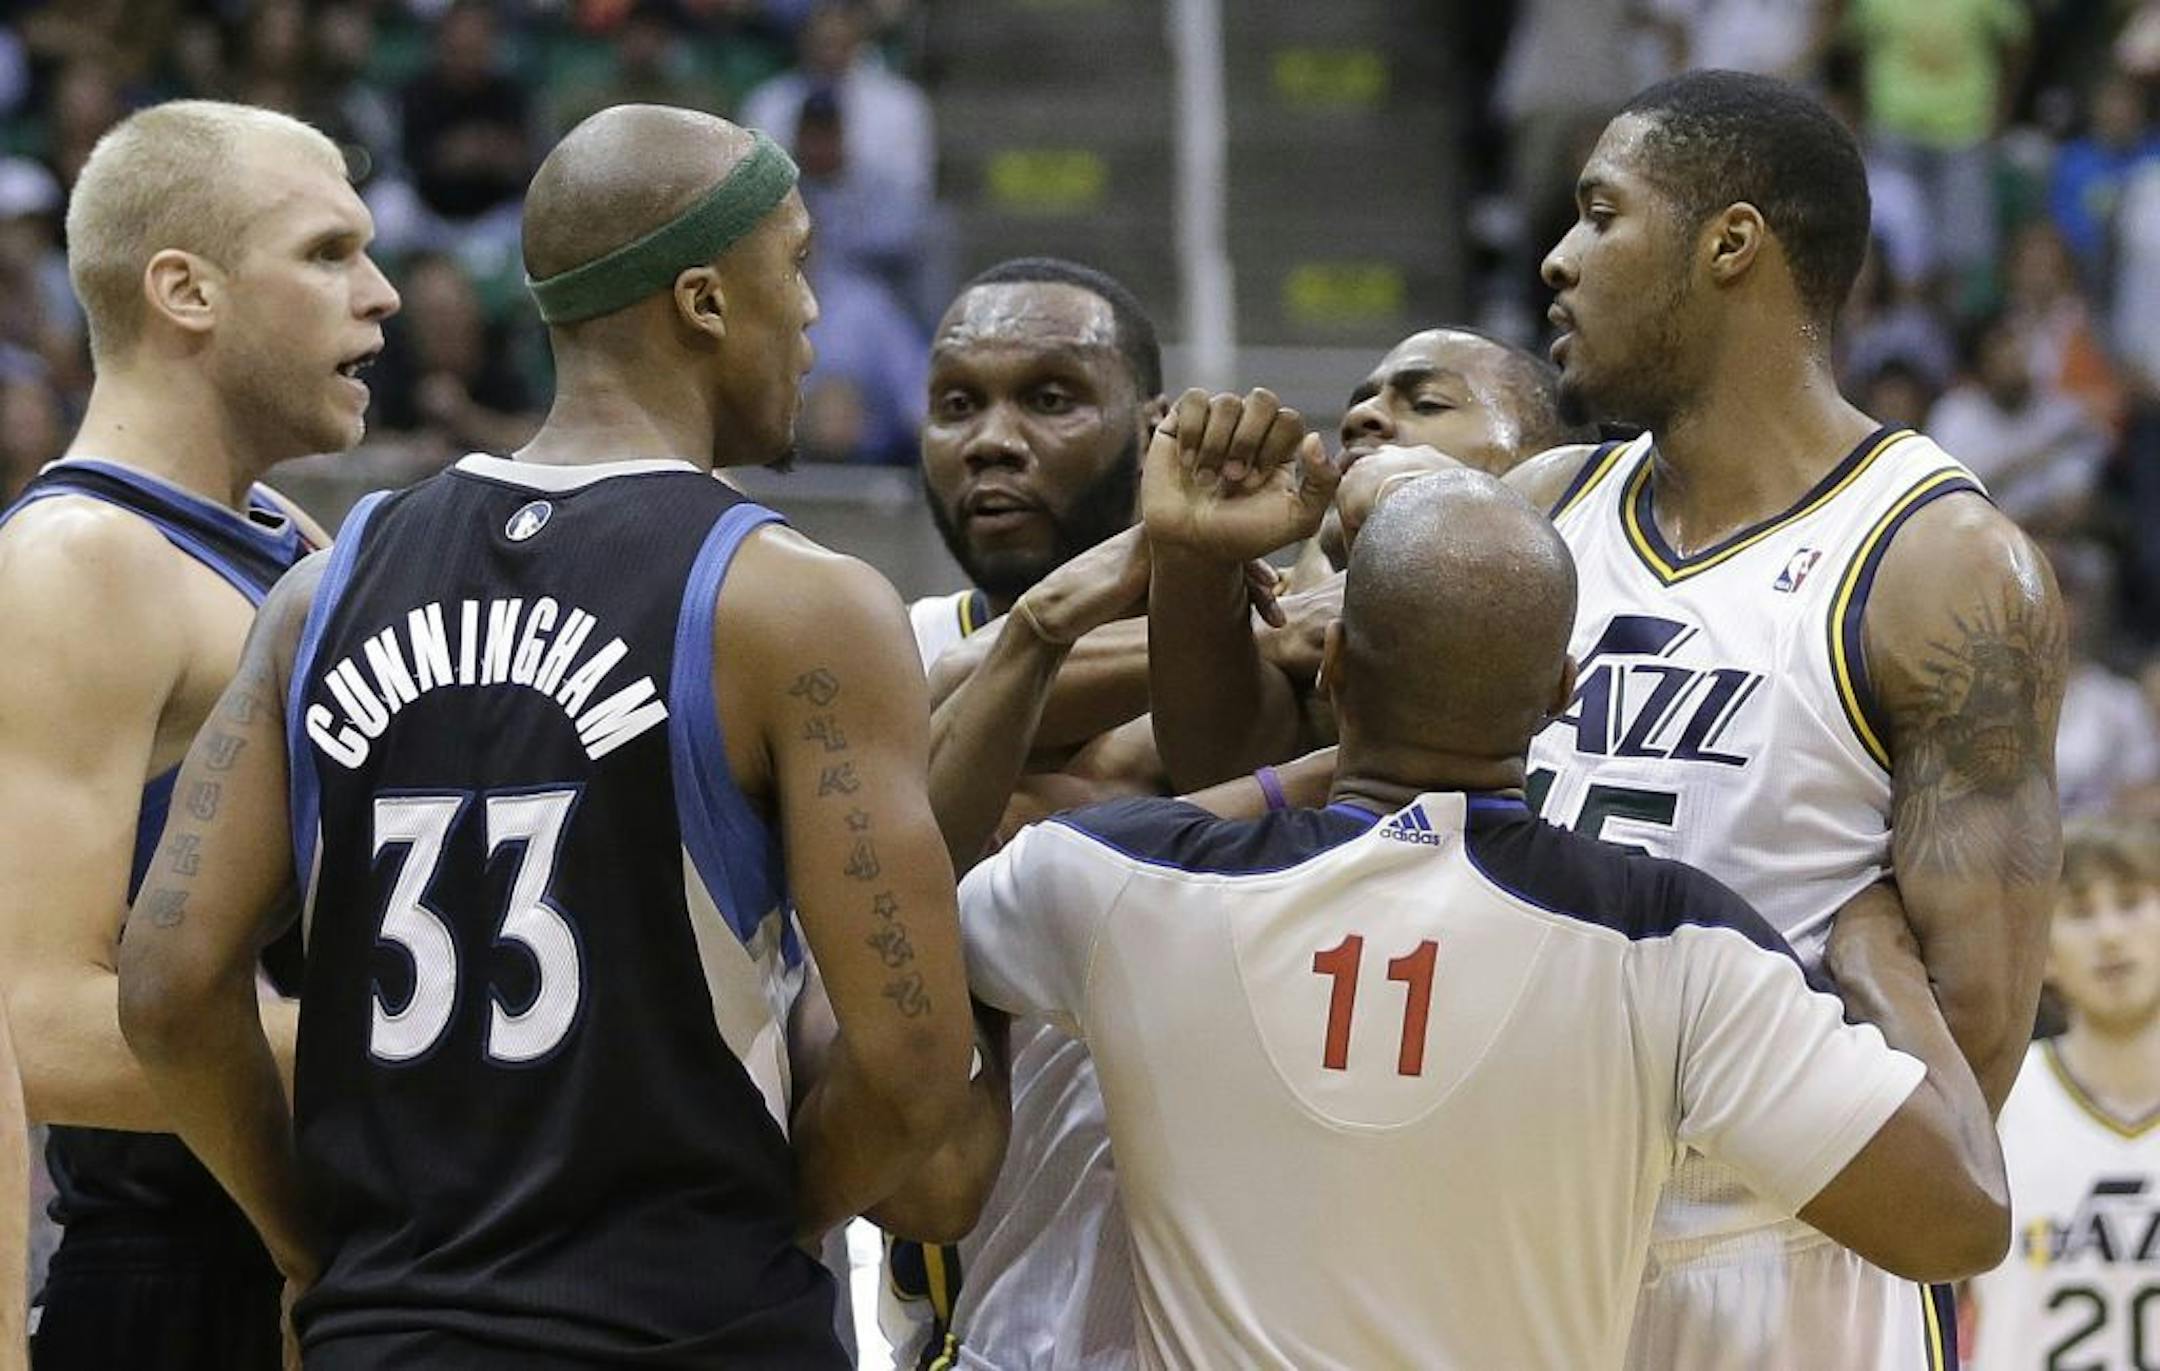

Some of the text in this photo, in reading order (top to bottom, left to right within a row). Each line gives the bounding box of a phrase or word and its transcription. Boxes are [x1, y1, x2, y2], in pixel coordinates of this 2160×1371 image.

[306, 596, 669, 769] CUNNINGHAM
[1380, 828, 1440, 846] adidas
[367, 785, 585, 1064] 33
[1312, 934, 1439, 1077] 11
